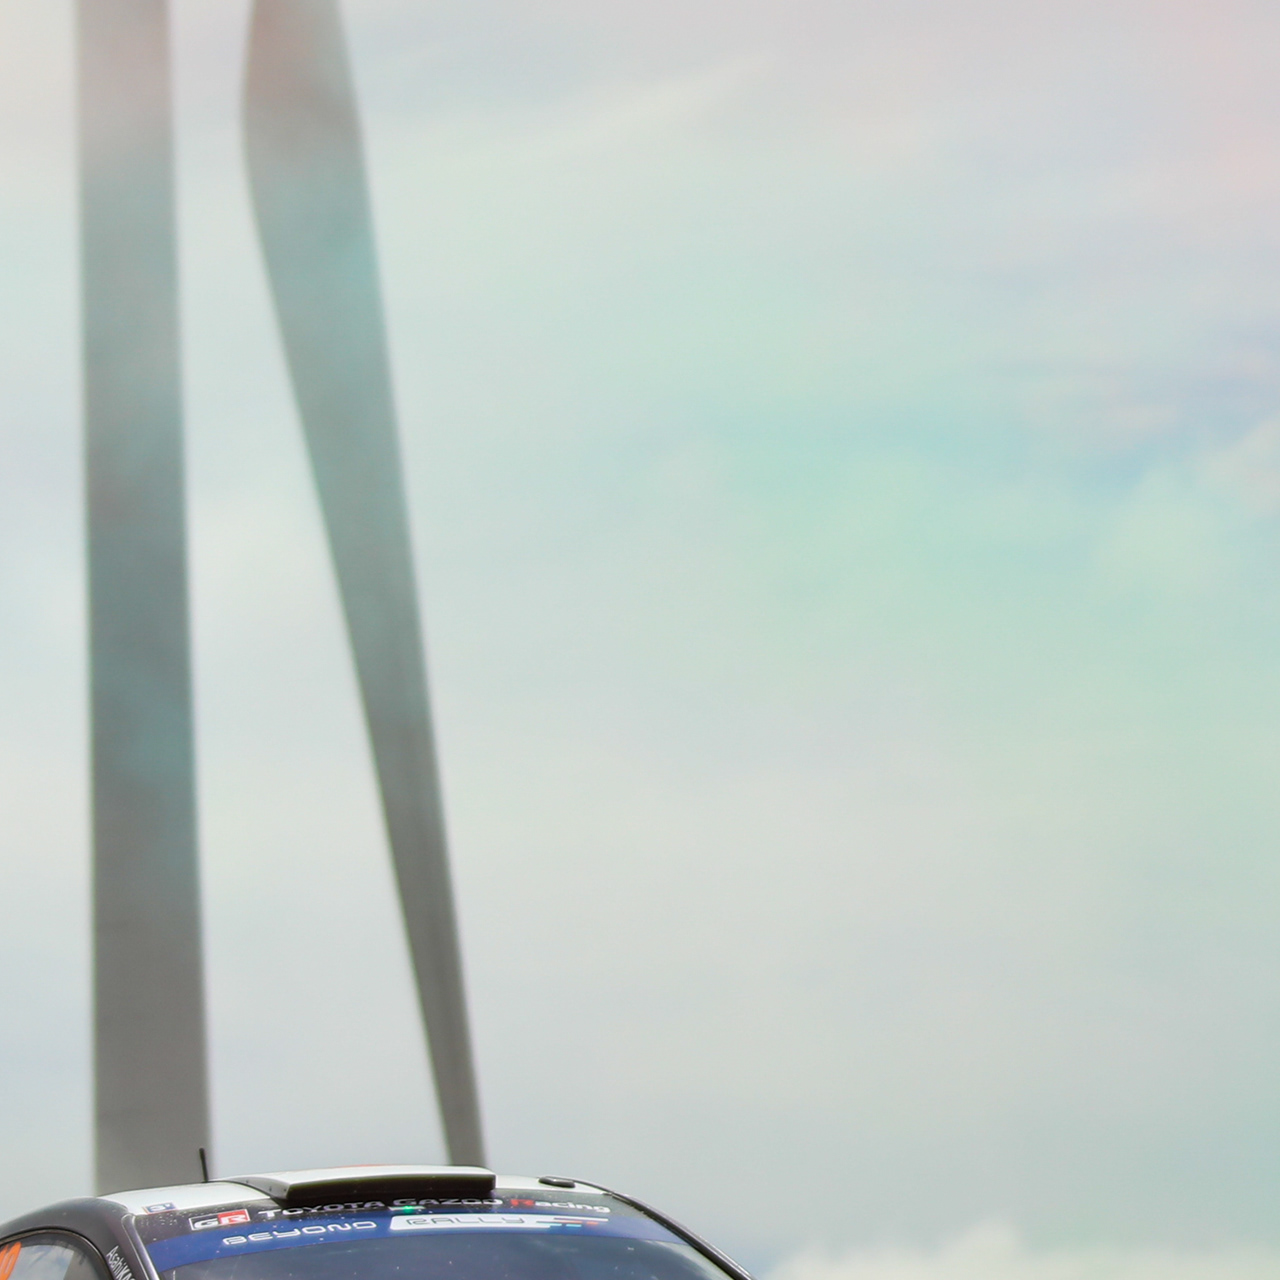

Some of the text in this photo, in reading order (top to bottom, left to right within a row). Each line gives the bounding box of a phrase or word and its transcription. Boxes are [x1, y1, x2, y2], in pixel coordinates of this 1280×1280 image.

[258, 1201, 384, 1218] TOYOTA
[510, 1198, 611, 1213] Racing
[222, 1216, 525, 1246] BEYOND RALLY
